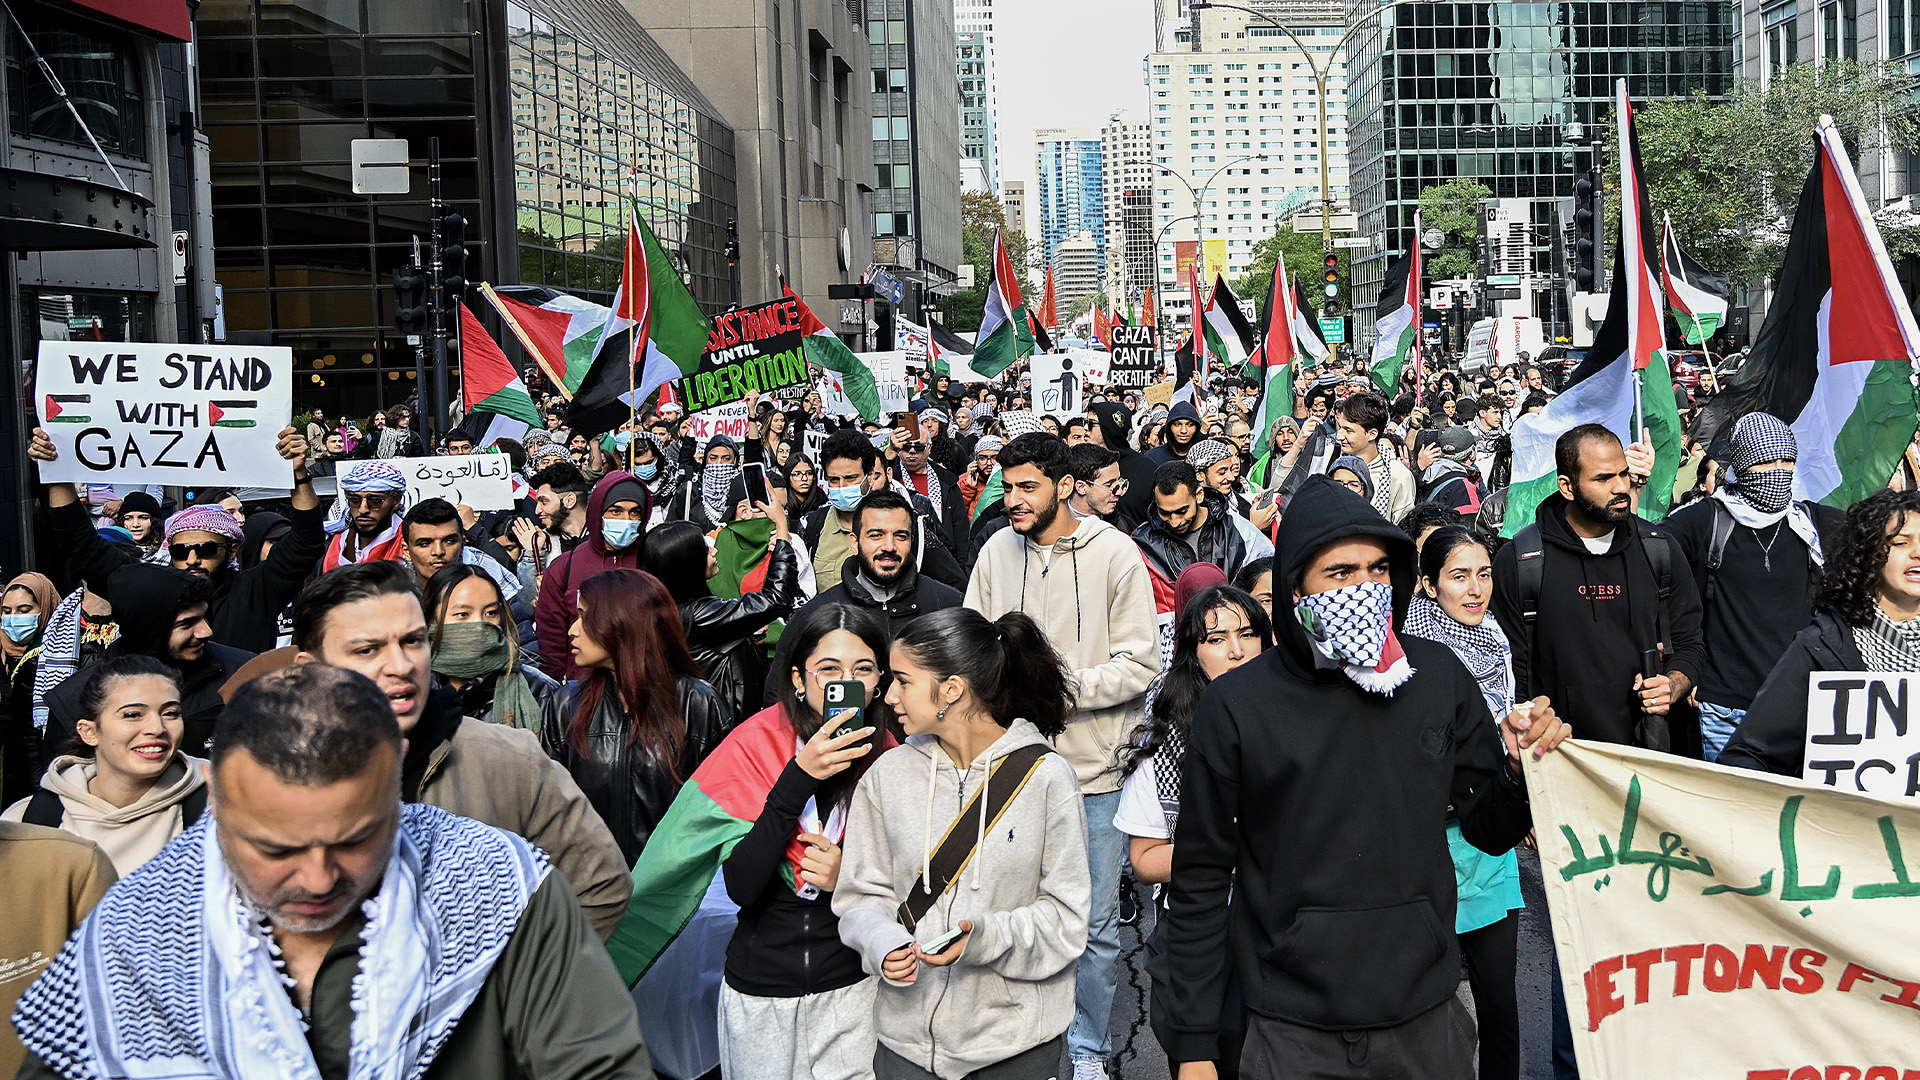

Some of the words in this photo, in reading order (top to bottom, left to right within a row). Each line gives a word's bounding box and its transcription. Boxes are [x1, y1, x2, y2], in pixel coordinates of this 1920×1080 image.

[1112, 326, 1152, 345] GAZA
[710, 343, 760, 365] UNTIL
[67, 352, 139, 385] WE
[158, 352, 273, 392] STAND
[682, 346, 808, 411] LIBERATION
[875, 371, 898, 383] ILL
[1111, 369, 1155, 387] BREATHE
[115, 399, 199, 428] WITH
[718, 406, 748, 417] NEVER
[714, 418, 750, 438] AWAY
[74, 427, 227, 472] GAZA
[1578, 584, 1622, 595] GUESS
[1584, 943, 1828, 1033] ETTONS
